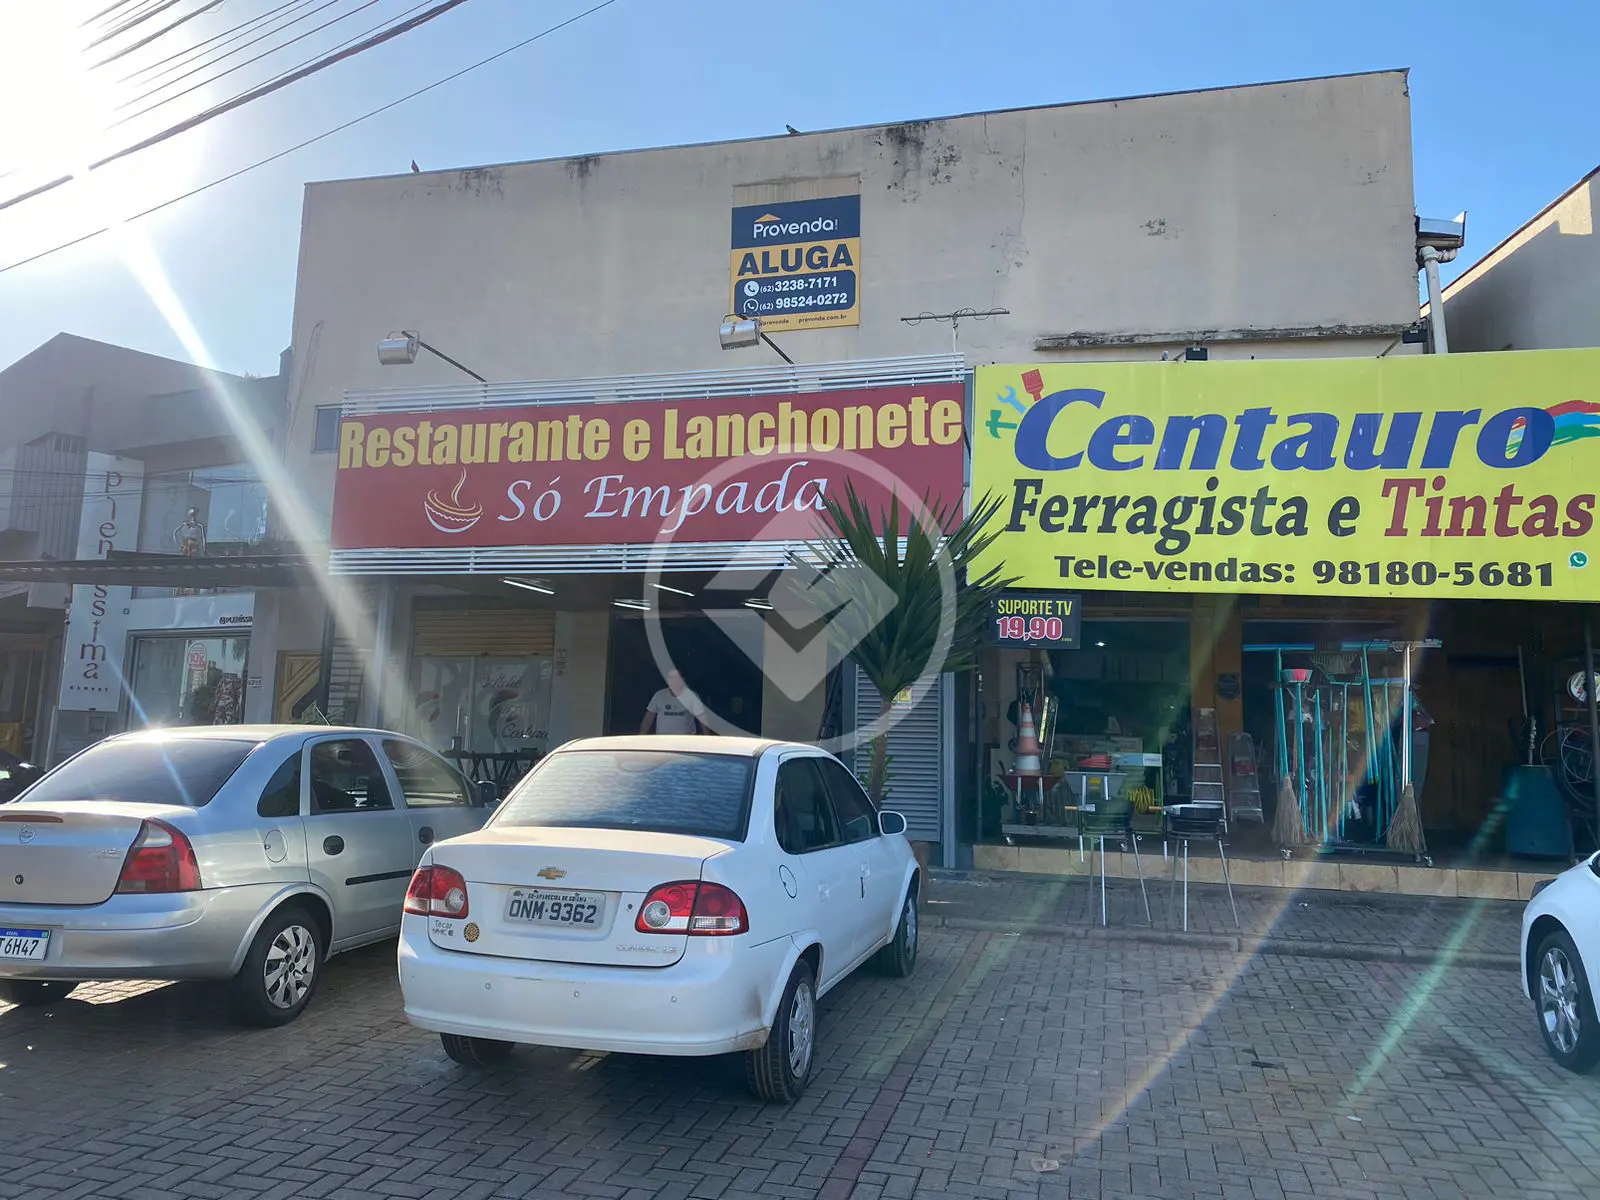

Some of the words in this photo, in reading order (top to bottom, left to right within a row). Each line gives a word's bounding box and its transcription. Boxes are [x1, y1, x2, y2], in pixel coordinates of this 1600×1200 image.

[753, 217, 834, 239] Provenda
[737, 243, 854, 277] ALUGA
[760, 284, 775, 293] (62)
[774, 276, 838, 293] 3238-7171
[759, 303, 774, 311] (62)
[775, 292, 848, 310] 98524-0272
[760, 318, 790, 327] provenda
[338, 414, 610, 470] Restaurante
[623, 418, 651, 462] e
[664, 398, 963, 461] Lanchonete
[1014, 388, 1556, 472] Centauro
[498, 475, 562, 523] Só
[583, 460, 829, 535] Empada
[1006, 476, 1309, 556] Ferragista
[1327, 496, 1361, 536] e
[1380, 475, 1596, 538] Tintas
[1054, 555, 1295, 584] Tele-vendas:
[1313, 560, 1554, 588] 98180-5681
[997, 599, 1053, 615] SUPORTE
[1055, 600, 1073, 616] TV
[996, 615, 1063, 642] 19,90
